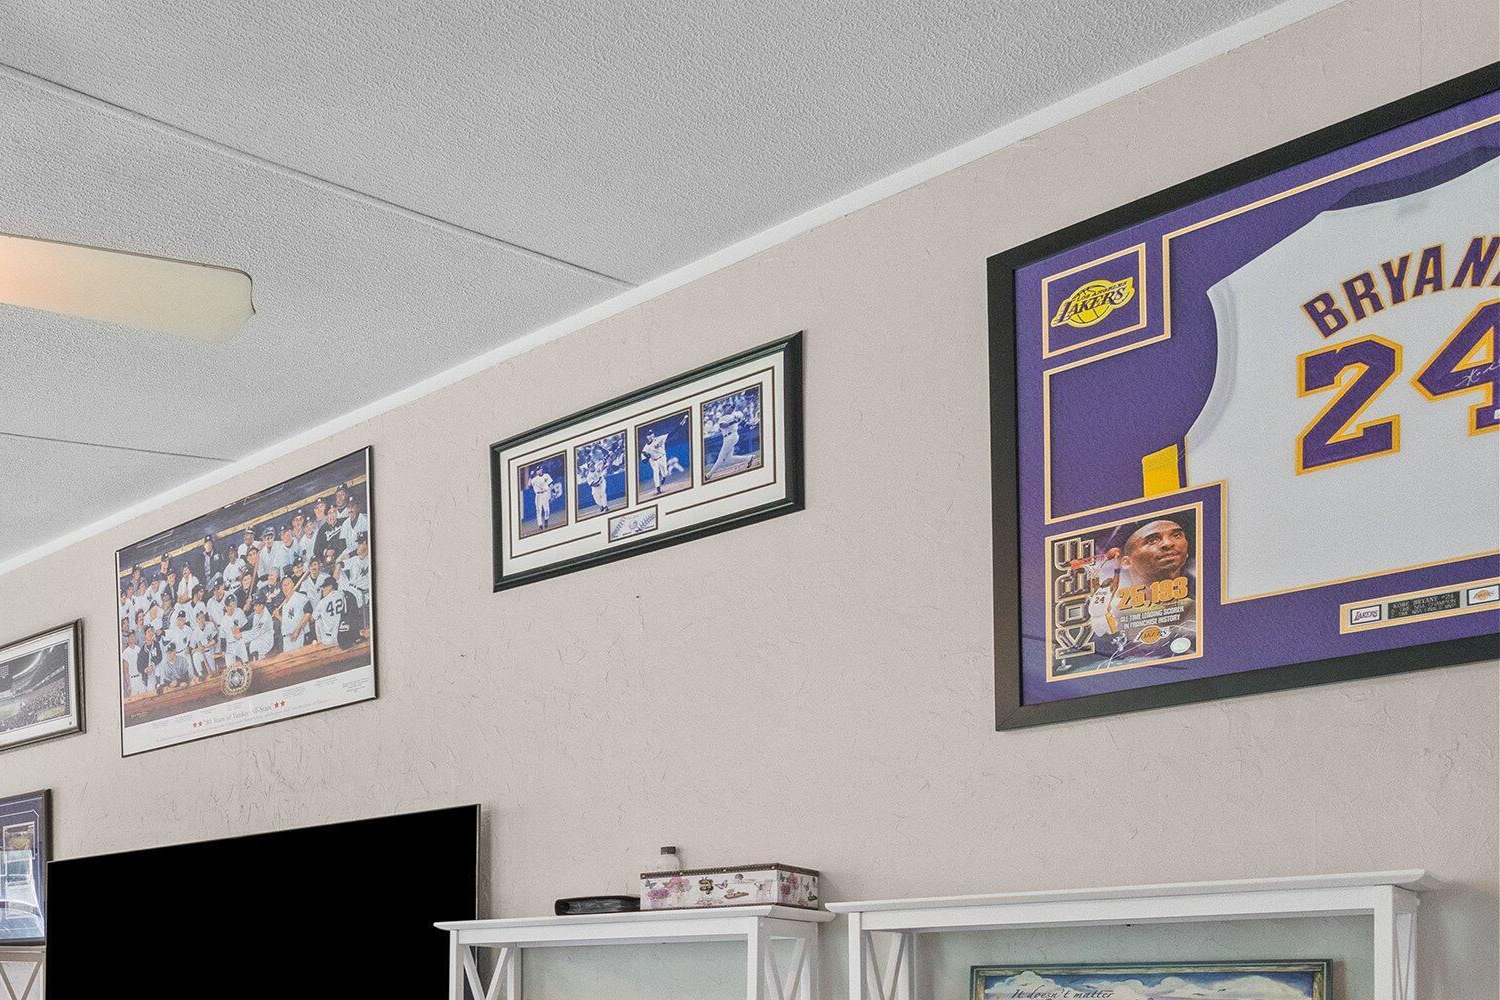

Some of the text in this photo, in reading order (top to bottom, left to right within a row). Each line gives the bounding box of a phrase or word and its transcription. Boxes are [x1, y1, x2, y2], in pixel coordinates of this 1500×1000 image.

[1057, 286, 1129, 322] LAKERS
[1301, 235, 1500, 338] BRYAN
[1295, 296, 1500, 476] 24
[325, 598, 343, 617] 42
[1054, 537, 1095, 660] KOBE
[1119, 576, 1188, 611] 25,193
[1353, 610, 1378, 622] LAKERS
[1012, 985, 1114, 999] It doesn't matter
